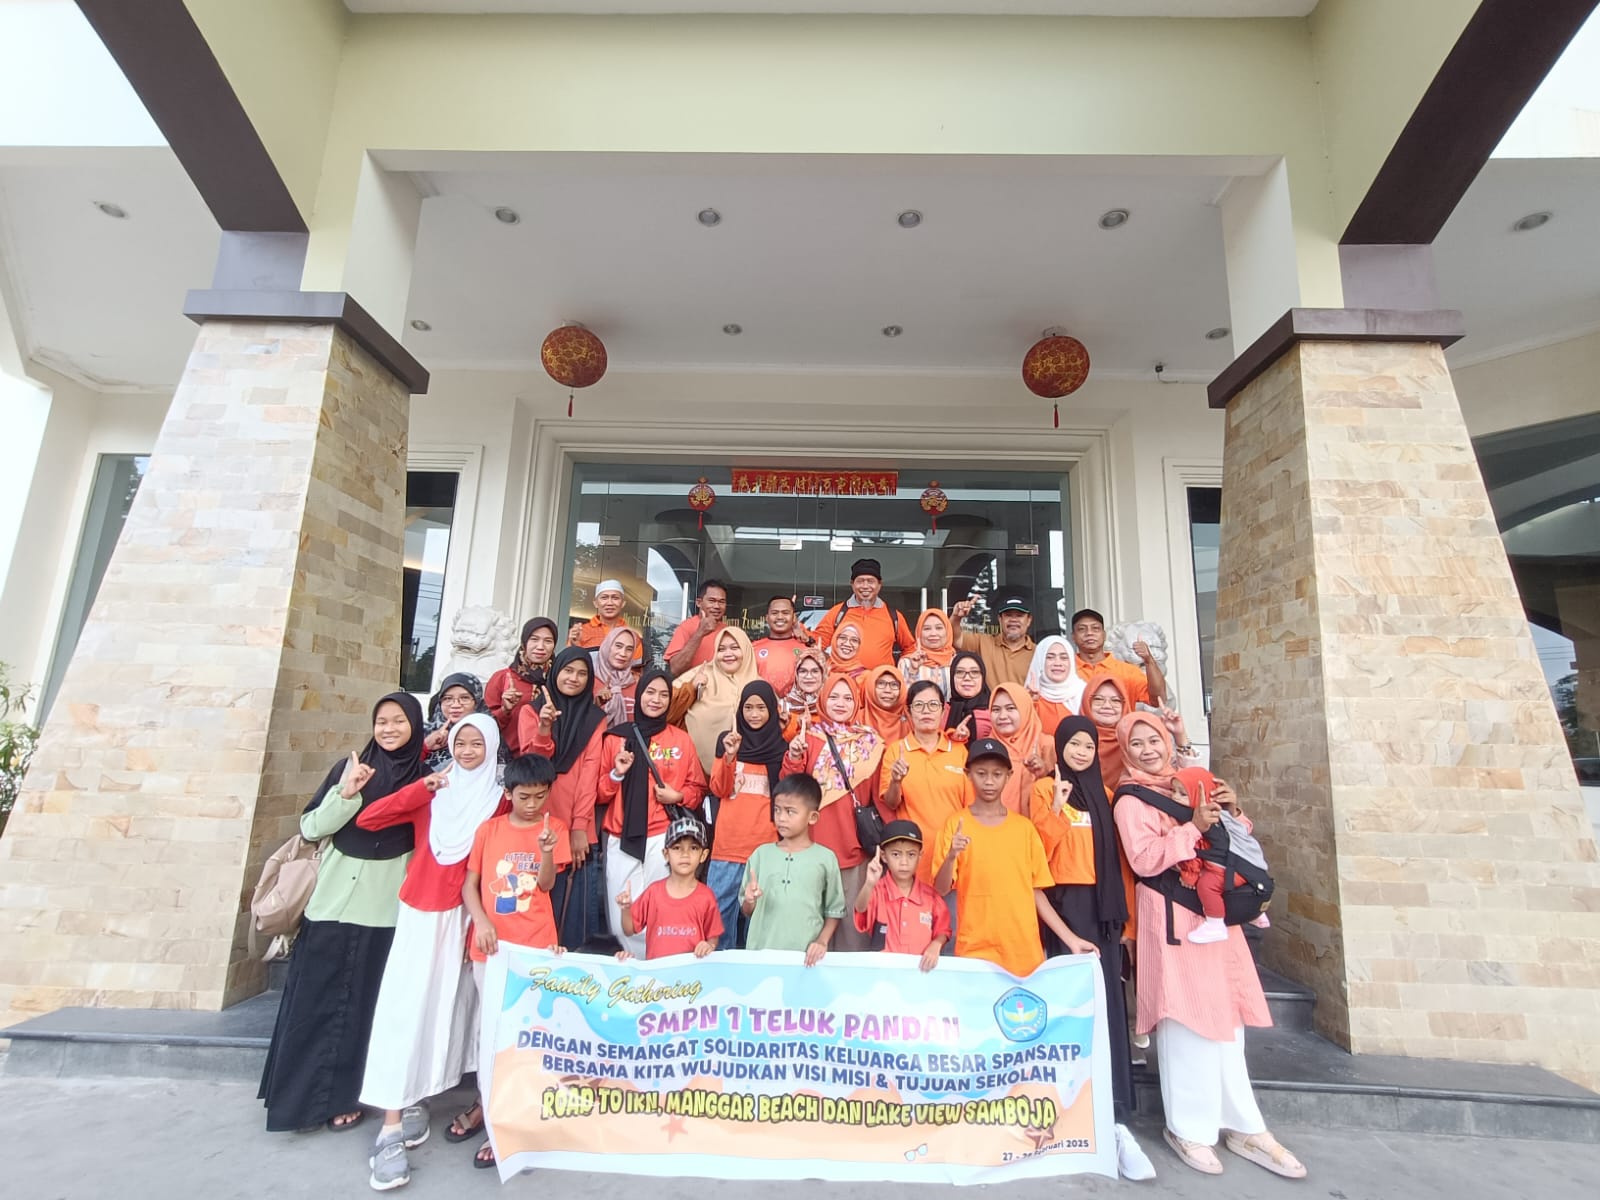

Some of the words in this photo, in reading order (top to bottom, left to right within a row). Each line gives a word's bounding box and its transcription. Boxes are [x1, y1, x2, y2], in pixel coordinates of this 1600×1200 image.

[504, 852, 535, 862] LITTLE
[517, 861, 541, 871] BEAR
[529, 967, 601, 1006] Family
[607, 975, 703, 1008] Gathering
[638, 1005, 718, 1036] SMPN
[726, 1006, 740, 1030] 1
[750, 1007, 834, 1034] TELUK
[844, 1012, 960, 1041] PANDAN
[517, 1030, 592, 1056] DENGAN
[597, 1039, 698, 1060] SEMANGAT
[704, 1038, 819, 1059] SOLIDARITAS
[824, 1042, 922, 1072] KELUARGA
[927, 1053, 987, 1073] BESAR
[992, 1044, 1081, 1070] SPANSATP
[542, 1054, 627, 1079] BERSAMA
[634, 1064, 675, 1079] KITA
[681, 1060, 787, 1080] WUJUDKAN
[793, 1064, 826, 1083] VISI
[832, 1066, 871, 1087] MISI
[876, 1073, 889, 1089] &
[895, 1074, 970, 1091] TUJUAN
[975, 1066, 1057, 1089] SEKOLAH
[541, 1085, 593, 1120] ROAD
[597, 1087, 624, 1114] TO
[625, 1091, 662, 1116] IKN,
[665, 1088, 754, 1121] MANGGAR
[758, 1093, 821, 1123] BEACH
[822, 1097, 862, 1125] DAN
[865, 1099, 913, 1127] LAKE
[914, 1101, 961, 1125] VIEW
[964, 1094, 1057, 1129] SAMBOJA
[1002, 1152, 1013, 1161] 27
[1066, 1139, 1089, 1148] 2025
